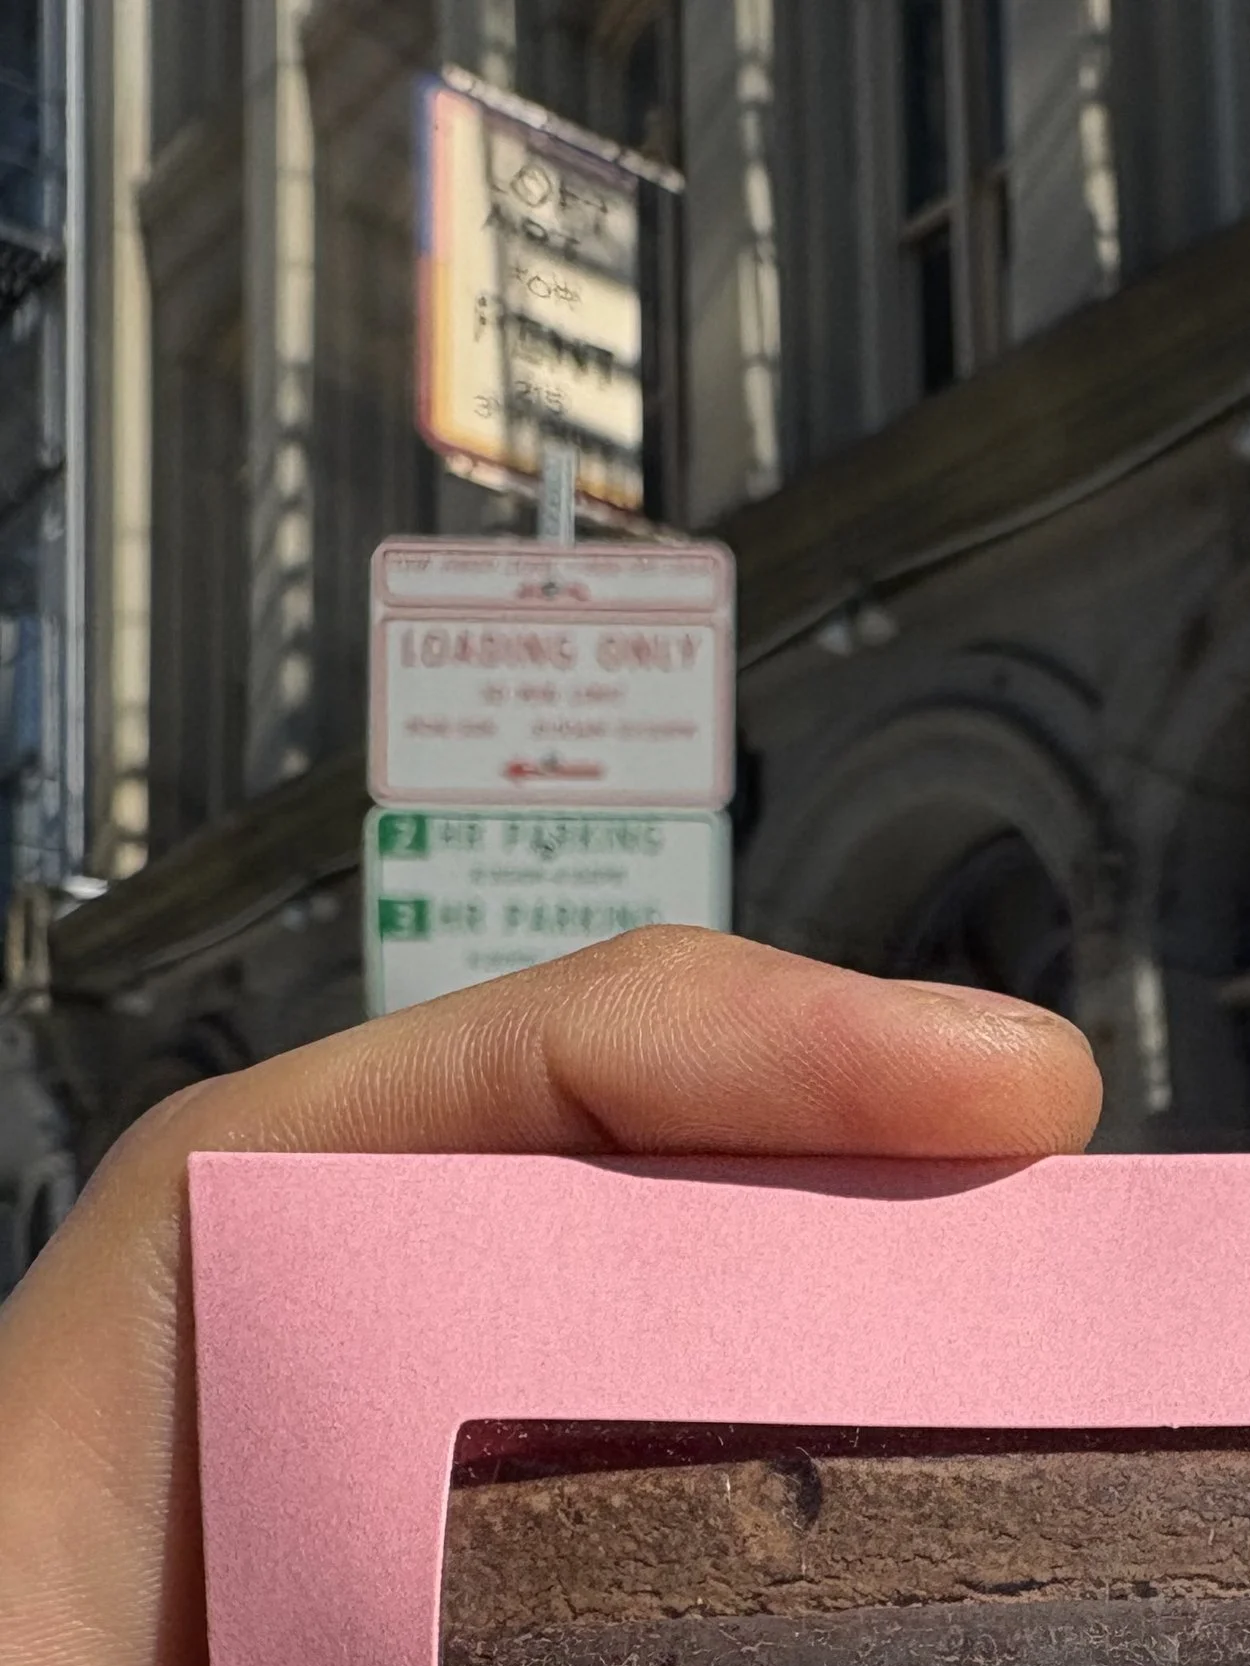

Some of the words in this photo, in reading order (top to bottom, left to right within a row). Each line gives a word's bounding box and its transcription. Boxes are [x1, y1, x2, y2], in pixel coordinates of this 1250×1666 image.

[400, 628, 577, 671] LOADING
[595, 630, 703, 673] ONLY
[504, 822, 664, 854] PARKING
